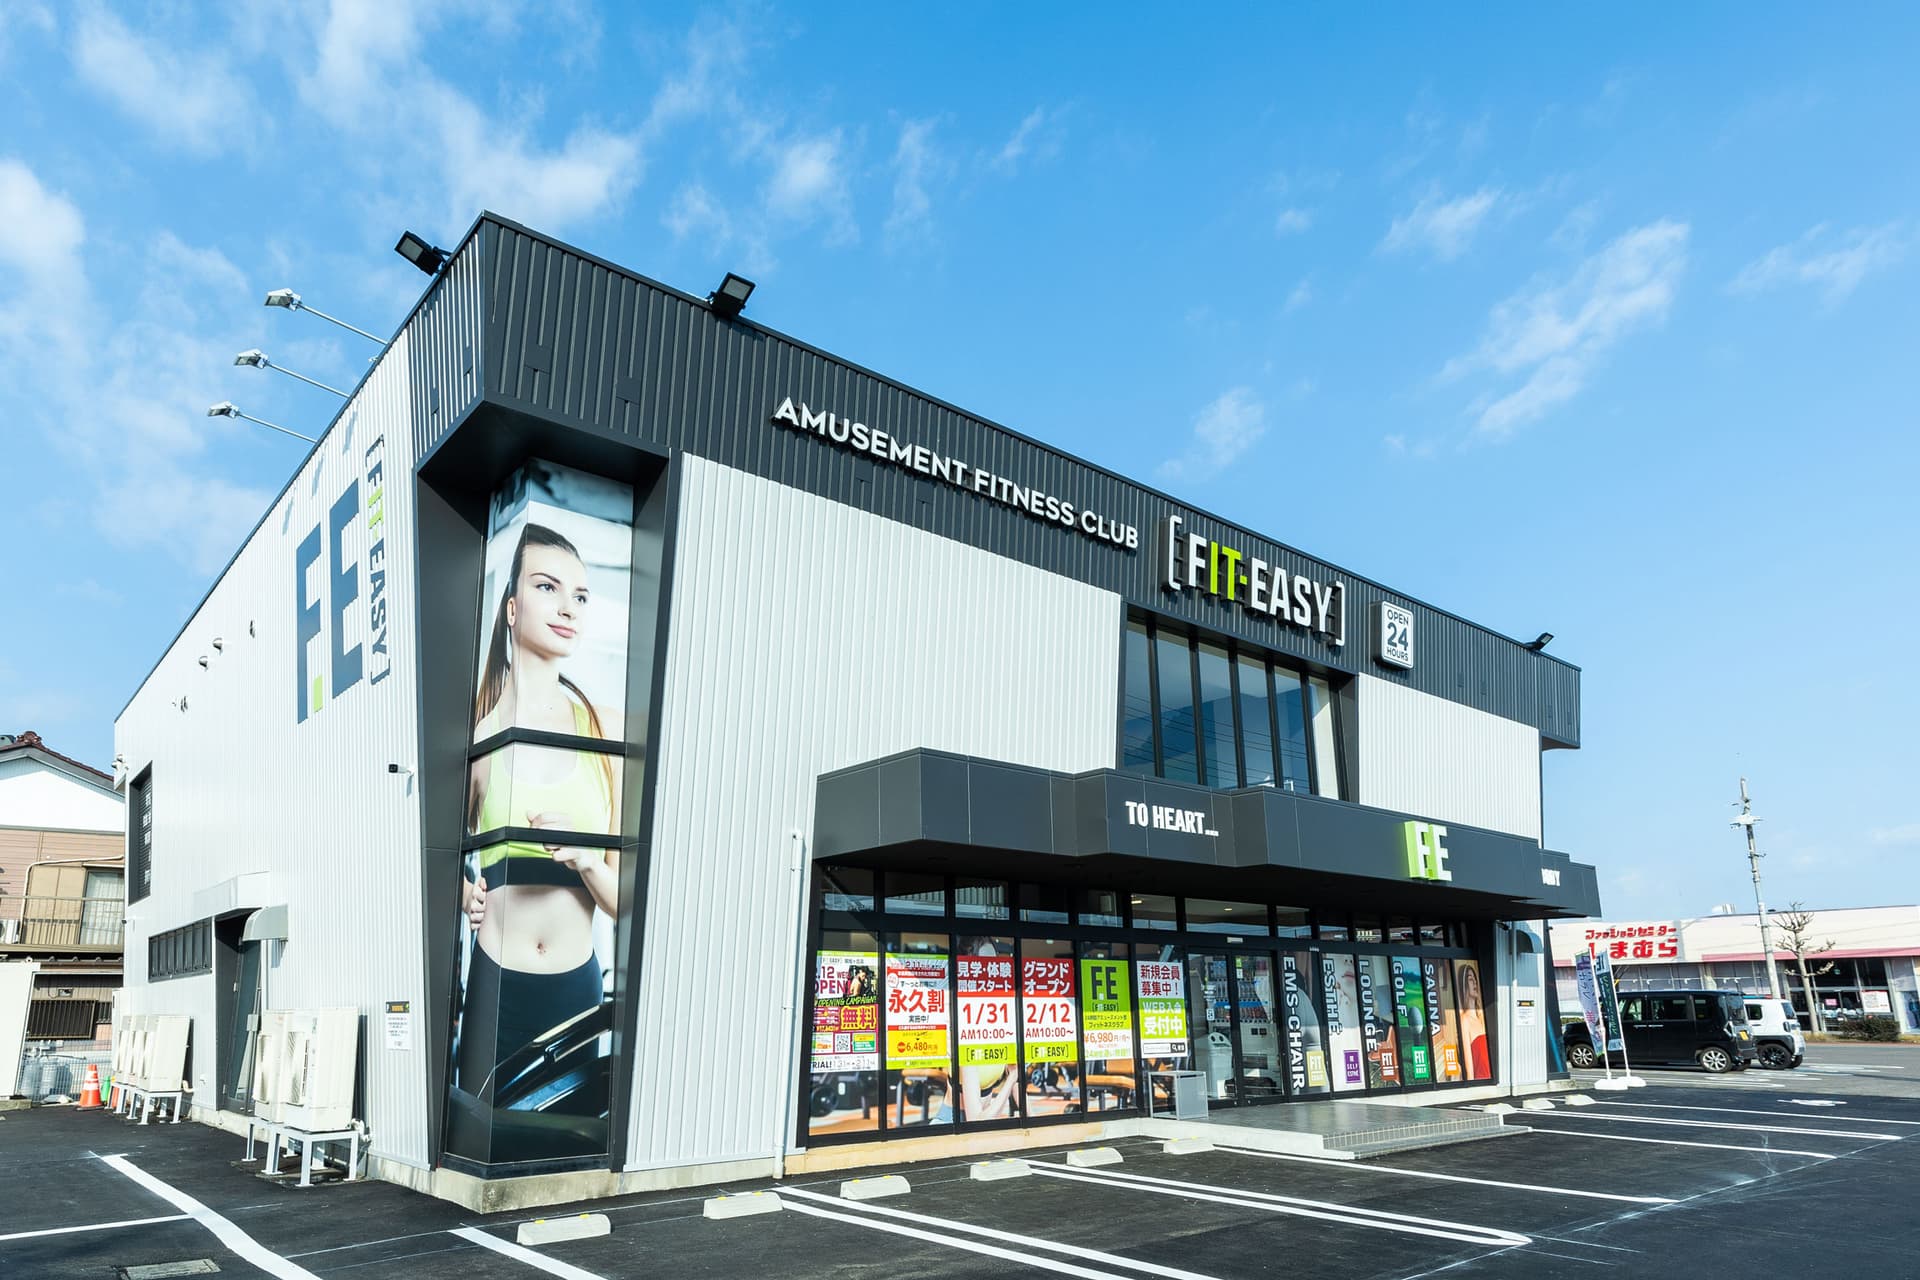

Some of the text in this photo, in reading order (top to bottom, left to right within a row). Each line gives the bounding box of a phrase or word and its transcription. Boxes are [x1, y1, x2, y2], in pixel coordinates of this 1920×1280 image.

[773, 397, 1138, 548] AMUSEMENT FITNESS CLUB
[1387, 609, 1409, 625] OPEN
[1387, 622, 1409, 651] 24
[1386, 648, 1408, 661] HOURS
[1125, 801, 1149, 827] TO
[1585, 925, 1676, 940] ファッションセンター
[957, 961, 1012, 978] 見学・体験
[1024, 961, 1070, 978] グランド
[1140, 965, 1180, 980] 新規会員
[957, 980, 1012, 993] 開催スタート
[1024, 979, 1070, 995] オープン
[1141, 981, 1178, 996] 募集中!
[1392, 961, 1408, 1017] GOLF
[888, 989, 944, 1013] 永久割
[1143, 1002, 1182, 1014] WEB入会
[1359, 960, 1378, 1052] LOUNGE
[1424, 963, 1441, 1036] SAUNA
[841, 1006, 876, 1030] 無料
[962, 1003, 1009, 1025] 1/31
[1027, 1003, 1070, 1024] 2/12
[1144, 1016, 1183, 1036] 受付中
[1282, 956, 1305, 1089] EMS-CHAIR
[1381, 1053, 1393, 1066] FIT
[1414, 1050, 1424, 1063] FIT
[1445, 1049, 1455, 1061] FIT
